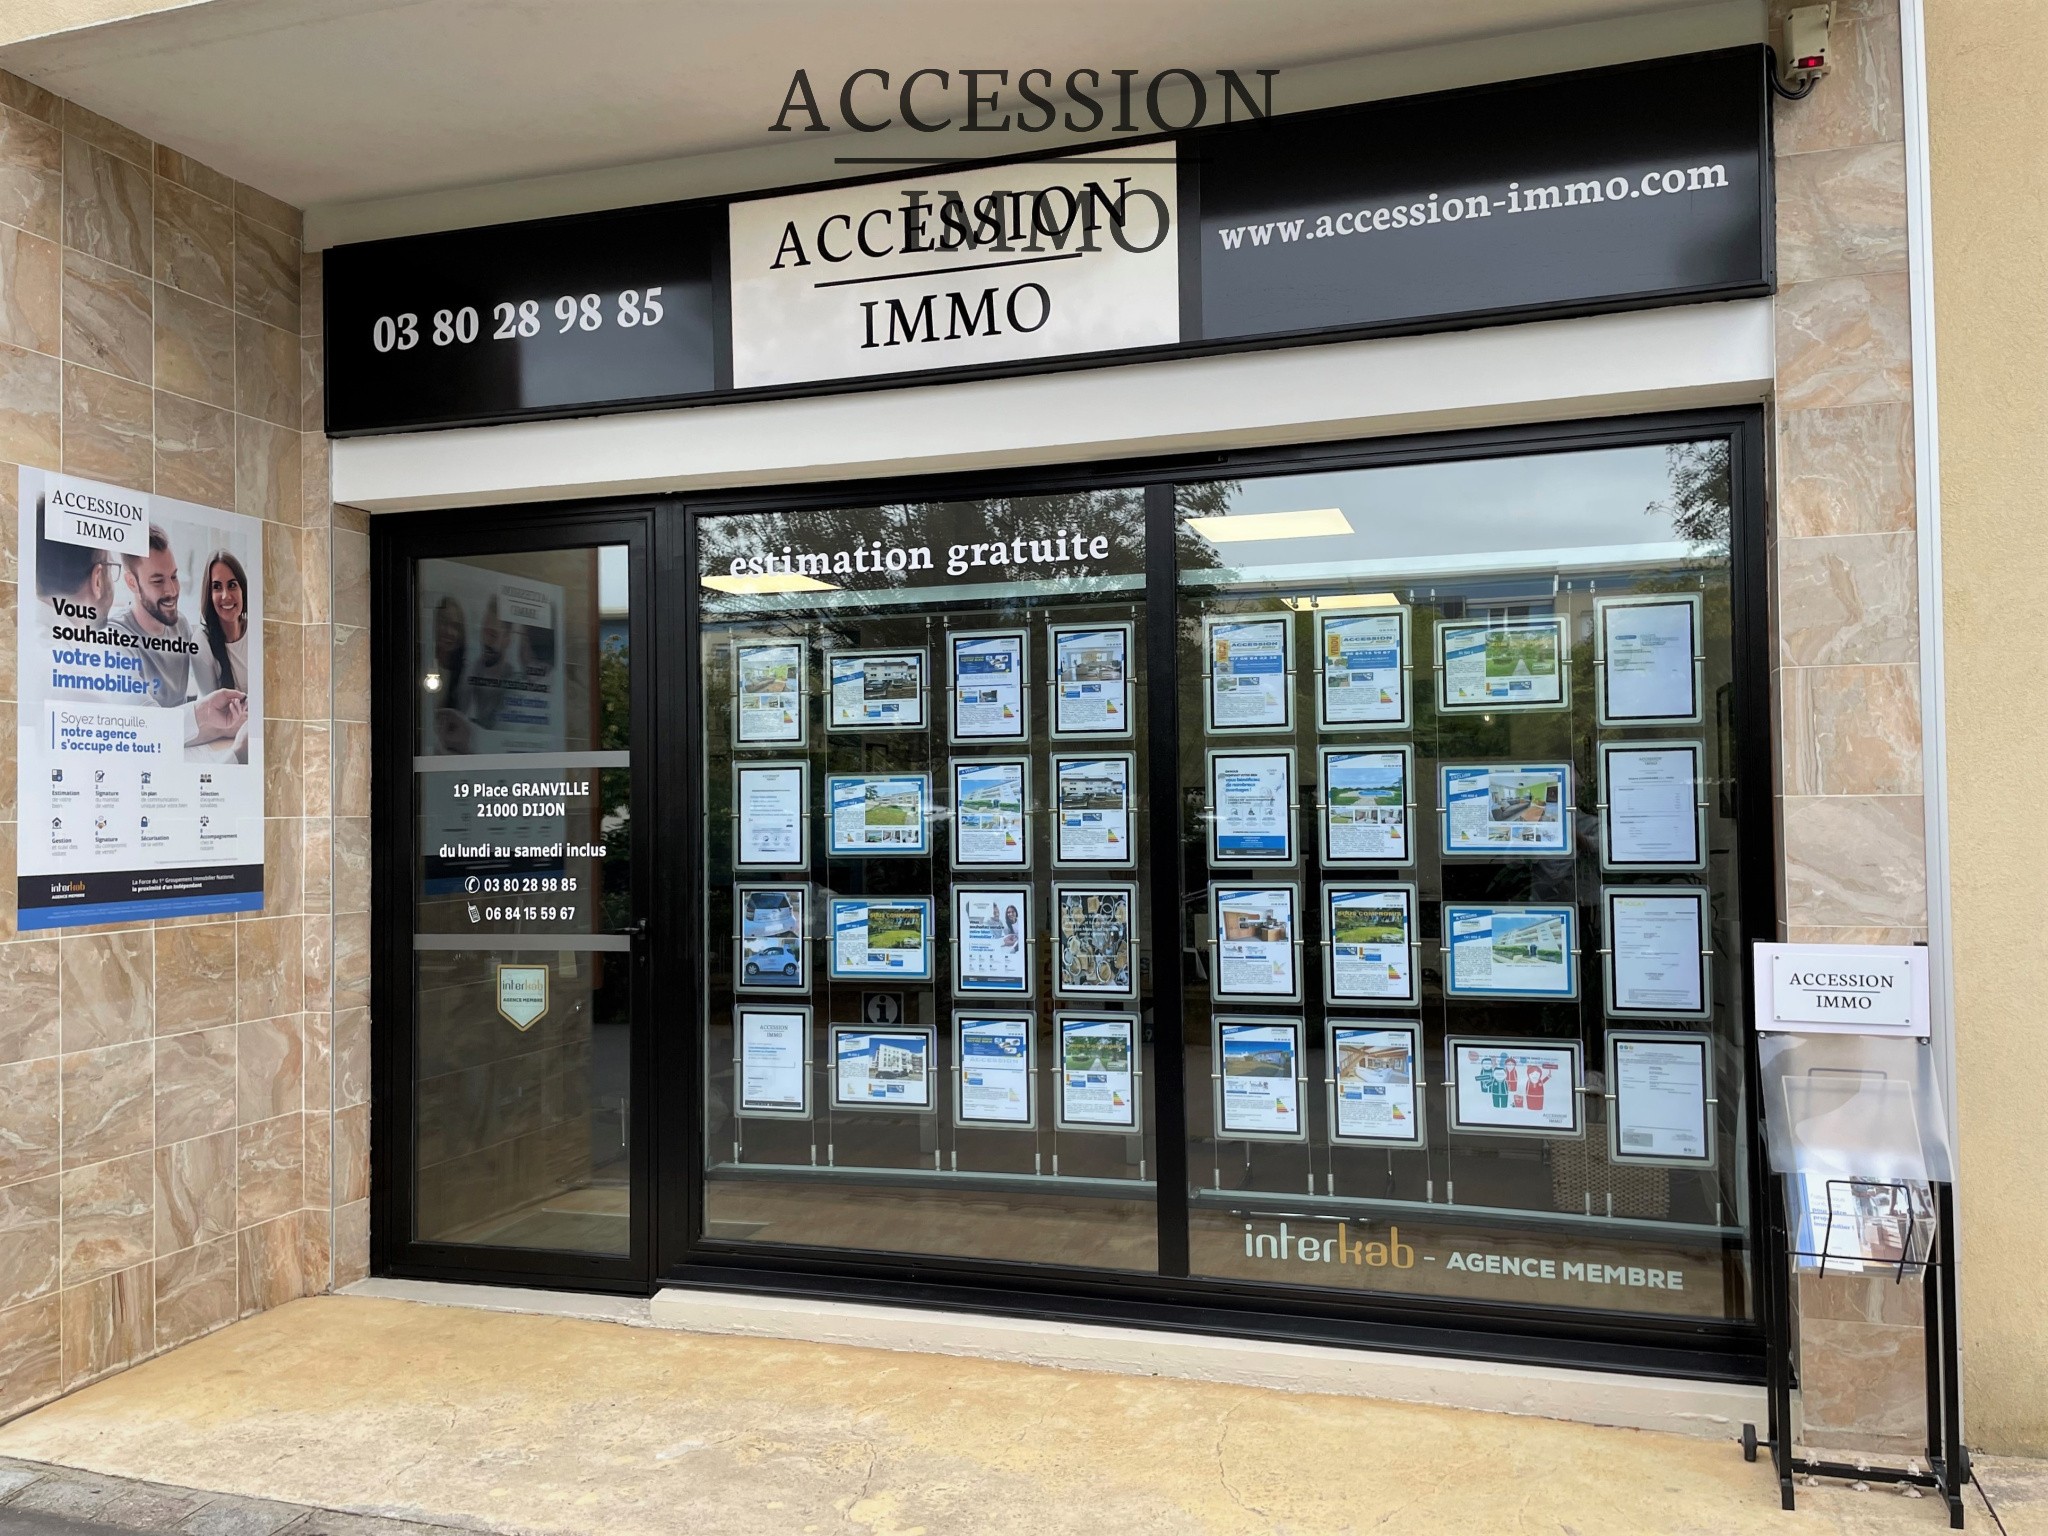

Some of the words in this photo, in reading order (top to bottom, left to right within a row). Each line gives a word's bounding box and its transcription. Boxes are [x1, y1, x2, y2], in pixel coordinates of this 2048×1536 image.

[1219, 164, 1729, 250] www.accession-immo.com
[769, 177, 1132, 270] ACCESSION
[373, 312, 419, 352] 03
[433, 306, 479, 346] 80
[493, 300, 540, 340] 28
[554, 293, 602, 334] 98
[617, 286, 664, 328] 85
[860, 282, 1051, 348] IMMO
[52, 489, 143, 521] ACCESSION
[76, 520, 124, 542] IMMO
[730, 541, 934, 578] estimation
[946, 530, 1109, 576] gratuite
[52, 597, 97, 620] Vous
[52, 625, 139, 648] souhaitez
[141, 636, 199, 655] vendre
[52, 648, 101, 667] votre
[104, 650, 142, 671] bien
[52, 669, 149, 694] immobilier
[152, 678, 160, 695] ?
[60, 711, 94, 727] Soyez
[97, 714, 148, 729] tranquille,
[61, 727, 93, 738] notre
[95, 729, 137, 741] agence
[61, 739, 113, 754] s'occupe
[115, 741, 130, 752] de
[132, 742, 155, 753] tout
[157, 743, 160, 753] !
[453, 783, 470, 798] 19
[473, 783, 509, 797] Place
[512, 782, 589, 796] GRANVILLE
[477, 803, 518, 818] 21000
[522, 802, 566, 817] DIJON
[439, 844, 457, 858] du
[458, 844, 491, 857] lundi
[494, 846, 510, 857] au
[514, 843, 562, 857] samedi
[566, 843, 607, 857] inclus
[484, 878, 500, 892] 03
[503, 878, 519, 892] 80
[522, 878, 538, 892] 28
[542, 878, 557, 892] 98
[561, 878, 577, 892] 85
[485, 907, 501, 920] 06
[505, 907, 520, 920] 84
[524, 907, 537, 920] 15
[540, 907, 556, 920] 59
[560, 907, 576, 920] 67
[502, 977, 543, 992] interkab
[1789, 972, 1894, 988] ACCESSION
[1816, 995, 1872, 1009] IMMO
[1245, 1223, 1415, 1270] interkab
[1446, 1251, 1556, 1280] AGENCE
[1562, 1260, 1684, 1291] MEMBRE
